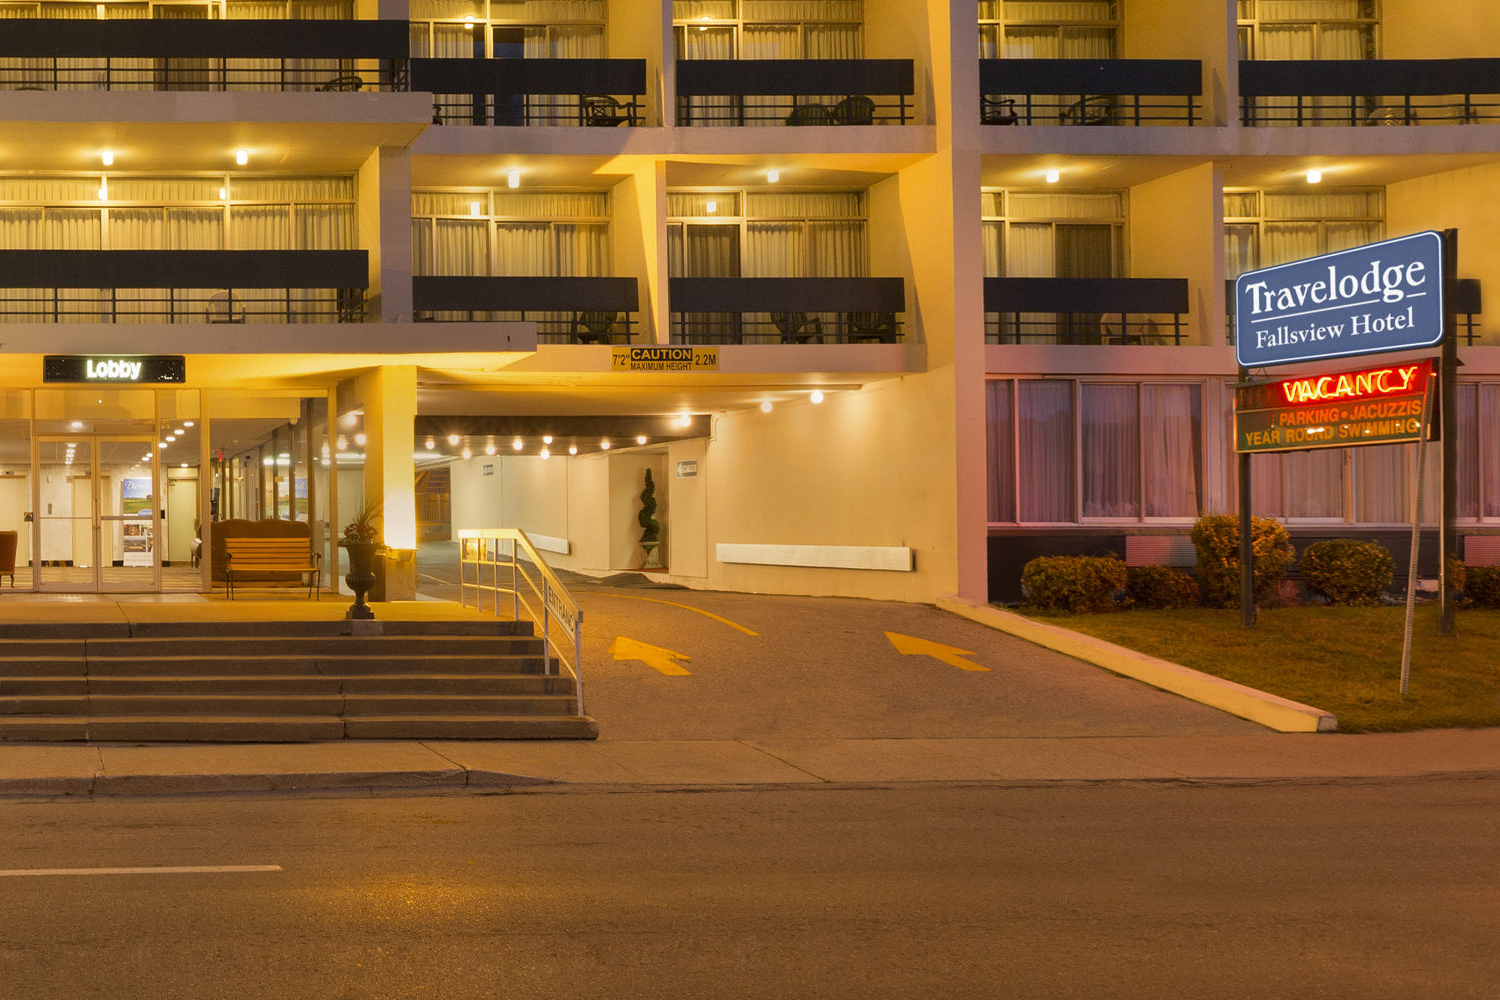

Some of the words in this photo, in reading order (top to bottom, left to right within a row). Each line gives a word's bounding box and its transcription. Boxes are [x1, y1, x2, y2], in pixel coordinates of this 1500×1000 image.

[1245, 260, 1426, 314] Travelodge
[1255, 323, 1345, 349] Fallsview
[1350, 306, 1415, 336] Hotel
[631, 349, 692, 360] CAUTION
[631, 362, 664, 371] MAXIMUM
[666, 362, 693, 371] HEIGHT
[695, 354, 716, 366] 2.2M
[86, 359, 142, 380] Lobby
[1283, 366, 1418, 402] VACANCY
[1279, 408, 1339, 426] PARKING
[1350, 400, 1422, 420] JACUZZIS
[1245, 430, 1280, 446] YEAR
[1286, 425, 1334, 443] ROUND
[1338, 418, 1419, 438] SWIMMING
[548, 586, 575, 632] ENTRANC
